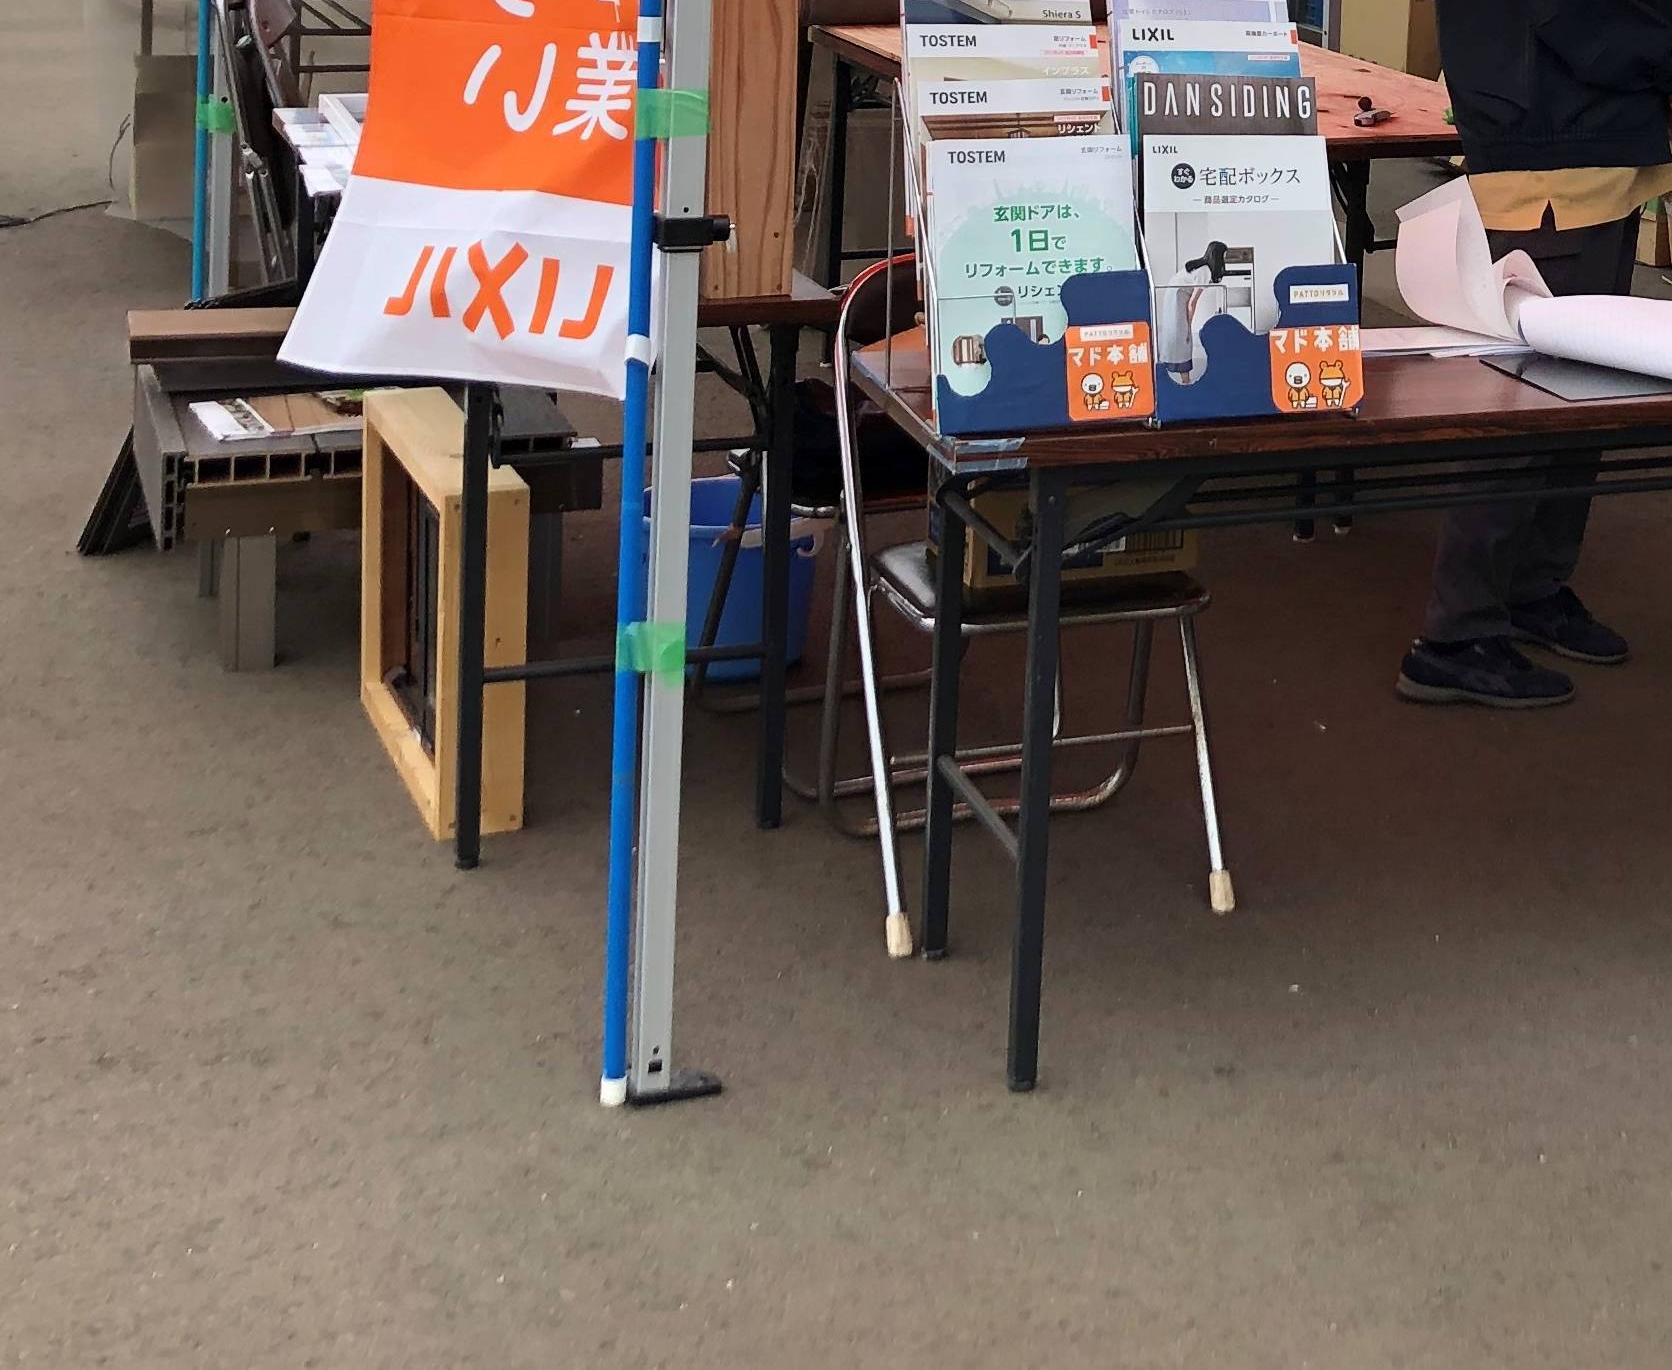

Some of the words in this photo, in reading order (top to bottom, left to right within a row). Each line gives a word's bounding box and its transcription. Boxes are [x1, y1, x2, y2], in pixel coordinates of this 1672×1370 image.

[1042, 9, 1073, 19] Shiera
[1074, 10, 1082, 19] S
[920, 35, 977, 48] TOSTEM
[1132, 28, 1175, 41] LIXIL
[929, 91, 988, 104] TOSTEM
[1152, 145, 1179, 154] LIXIL
[947, 150, 1006, 164] TOSTEM
[1199, 167, 1301, 186] 宅配ボックス
[1204, 194, 1270, 204] 商品選定カタログ
[993, 204, 1080, 222] 玄関ドアは、
[1010, 229, 1067, 252] 1日で
[965, 257, 1113, 278] リフォームできます。
[1271, 325, 1361, 354] マド本舗
[1068, 341, 1149, 367] マド本舗
